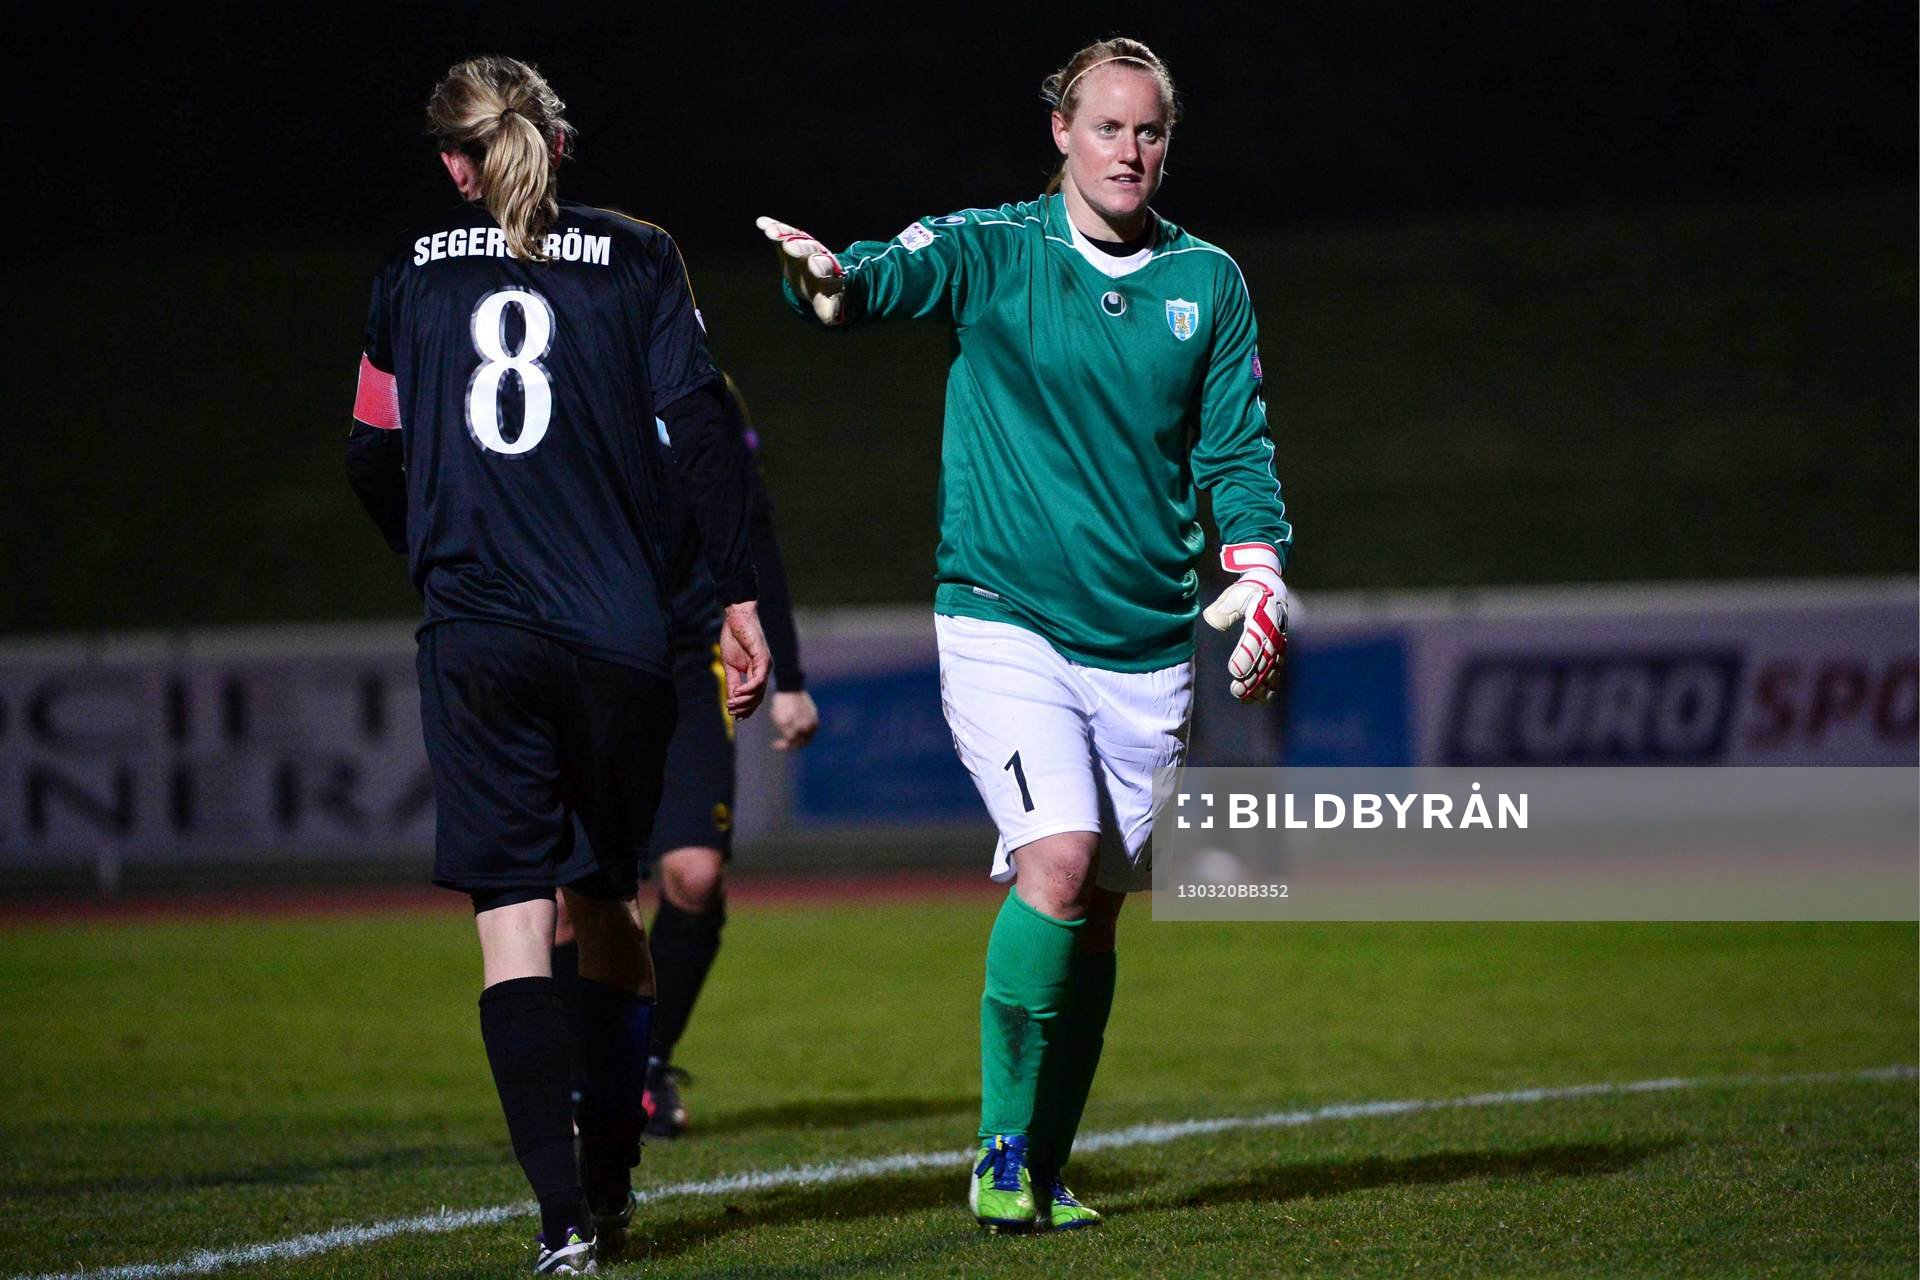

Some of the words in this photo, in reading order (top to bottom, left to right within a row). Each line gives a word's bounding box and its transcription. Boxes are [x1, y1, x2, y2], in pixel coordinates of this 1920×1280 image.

[413, 227, 611, 266] SEGERRÖM
[466, 286, 555, 457] 8
[1003, 750, 1036, 813] 1
